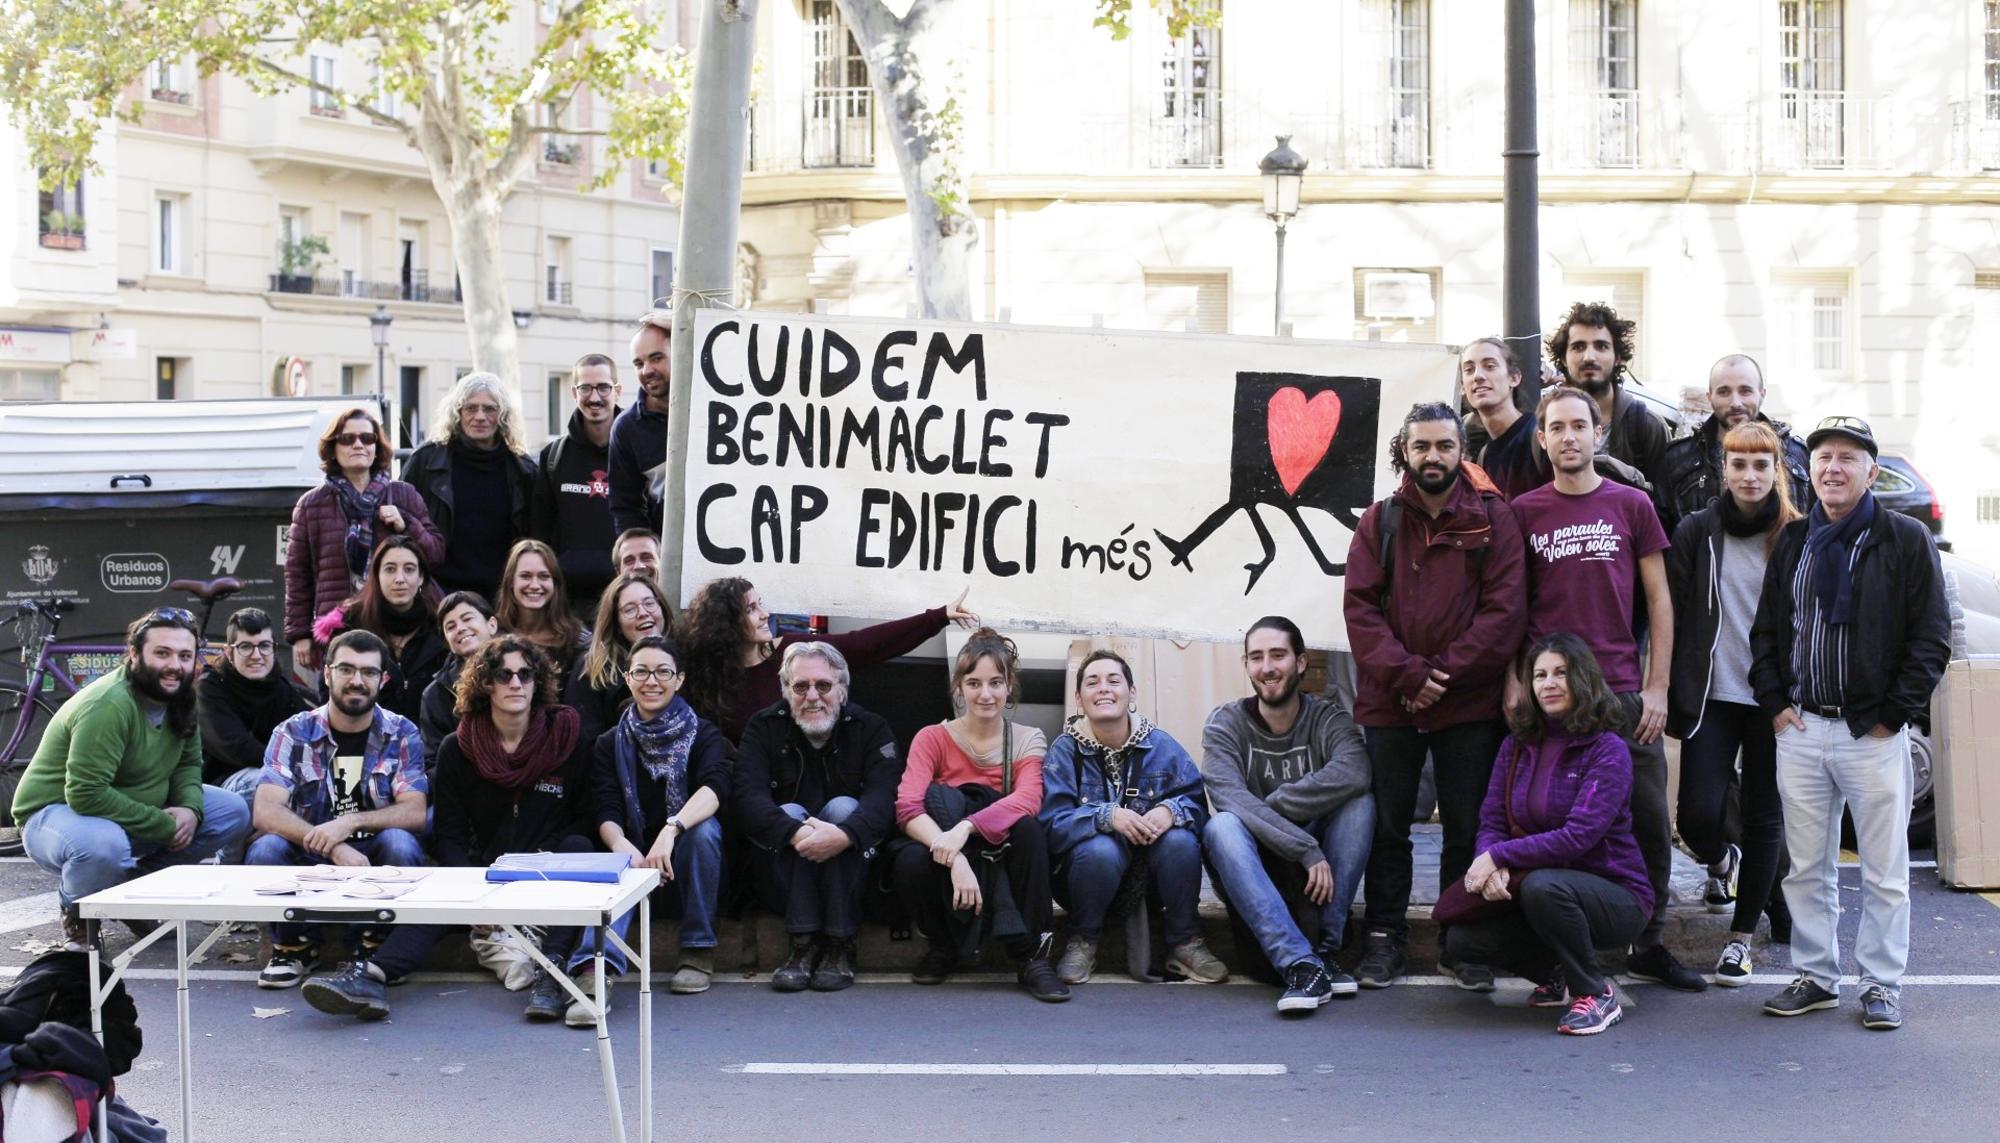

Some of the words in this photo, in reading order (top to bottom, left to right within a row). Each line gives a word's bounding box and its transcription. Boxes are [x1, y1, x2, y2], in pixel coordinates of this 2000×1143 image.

[700, 320, 987, 402] CUIDEM
[706, 400, 1070, 479] BENIMACLET
[696, 482, 829, 565] CAP
[855, 488, 1037, 577] EDIFICI
[1060, 522, 1152, 581] més
[1530, 533, 1549, 554] Les
[1553, 519, 1614, 544] paraules
[106, 560, 165, 572] Residuos
[110, 574, 162, 586] Urbanos
